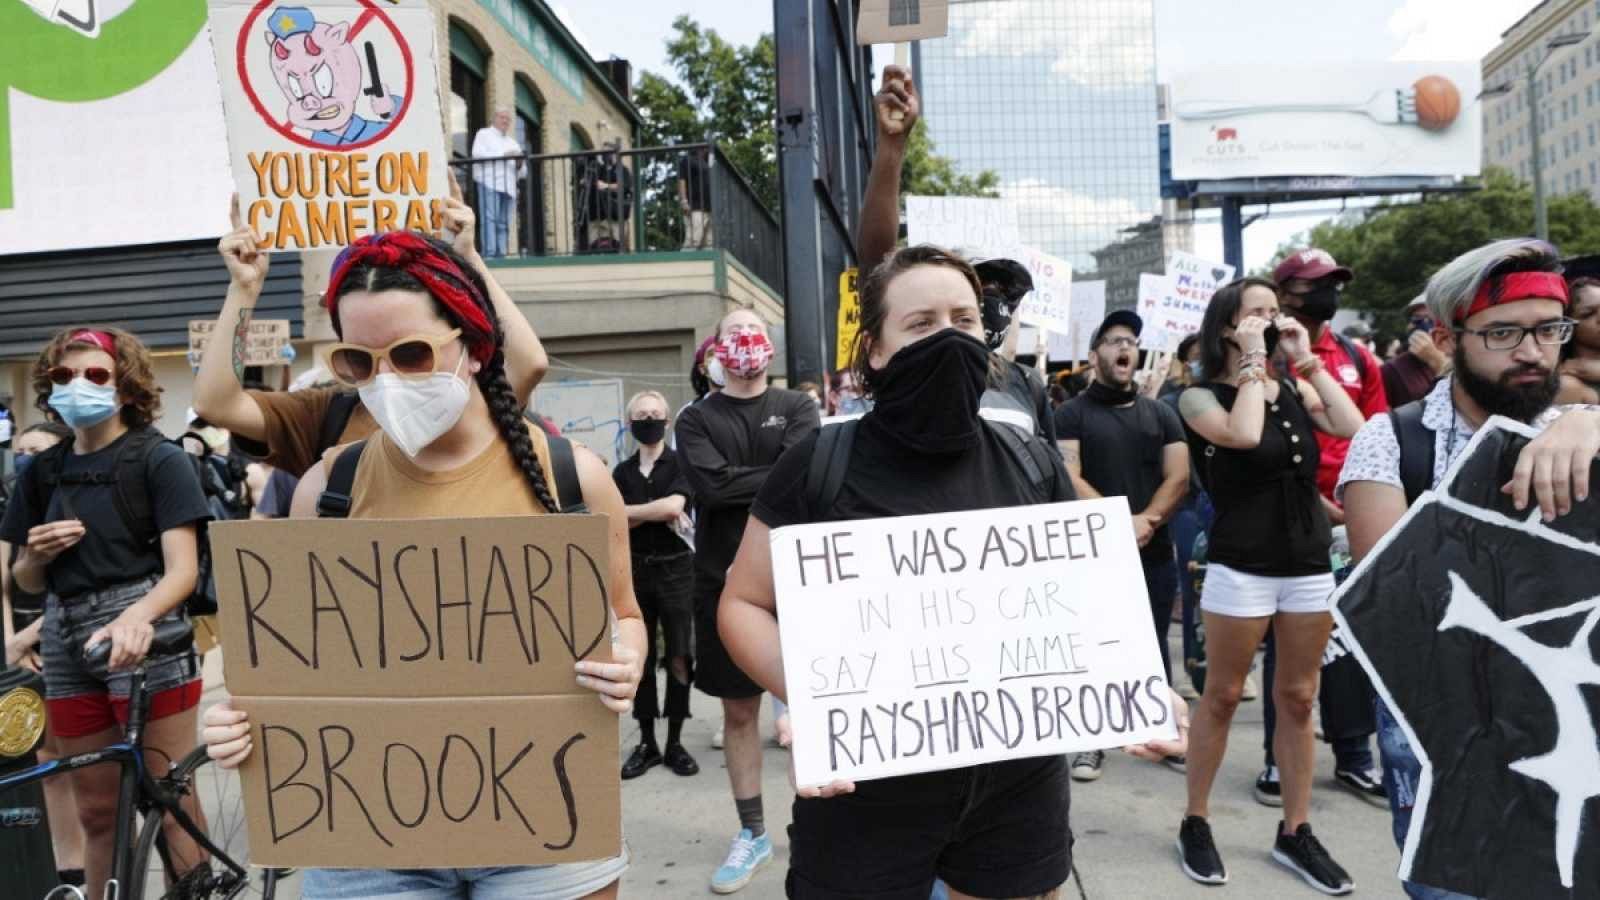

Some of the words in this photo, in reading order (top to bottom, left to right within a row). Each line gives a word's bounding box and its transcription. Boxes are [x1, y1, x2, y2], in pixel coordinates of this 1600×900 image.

[247, 151, 370, 200] YOU'RE
[376, 151, 429, 196] ON
[248, 198, 443, 249] CAMERA!
[796, 531, 860, 587] HE
[888, 526, 967, 577] WAS
[979, 512, 1107, 571] ASLEEP
[236, 536, 608, 670] RAYSHARD
[857, 598, 892, 632] IN
[920, 588, 976, 627] HIS
[998, 580, 1077, 620] CAR
[810, 652, 878, 691] SAY
[910, 643, 971, 681] HIS
[998, 633, 1089, 674] NAME
[829, 687, 1024, 771] RAYSHARD
[1032, 675, 1168, 742] BROOKS
[260, 723, 586, 850] BROOKS
